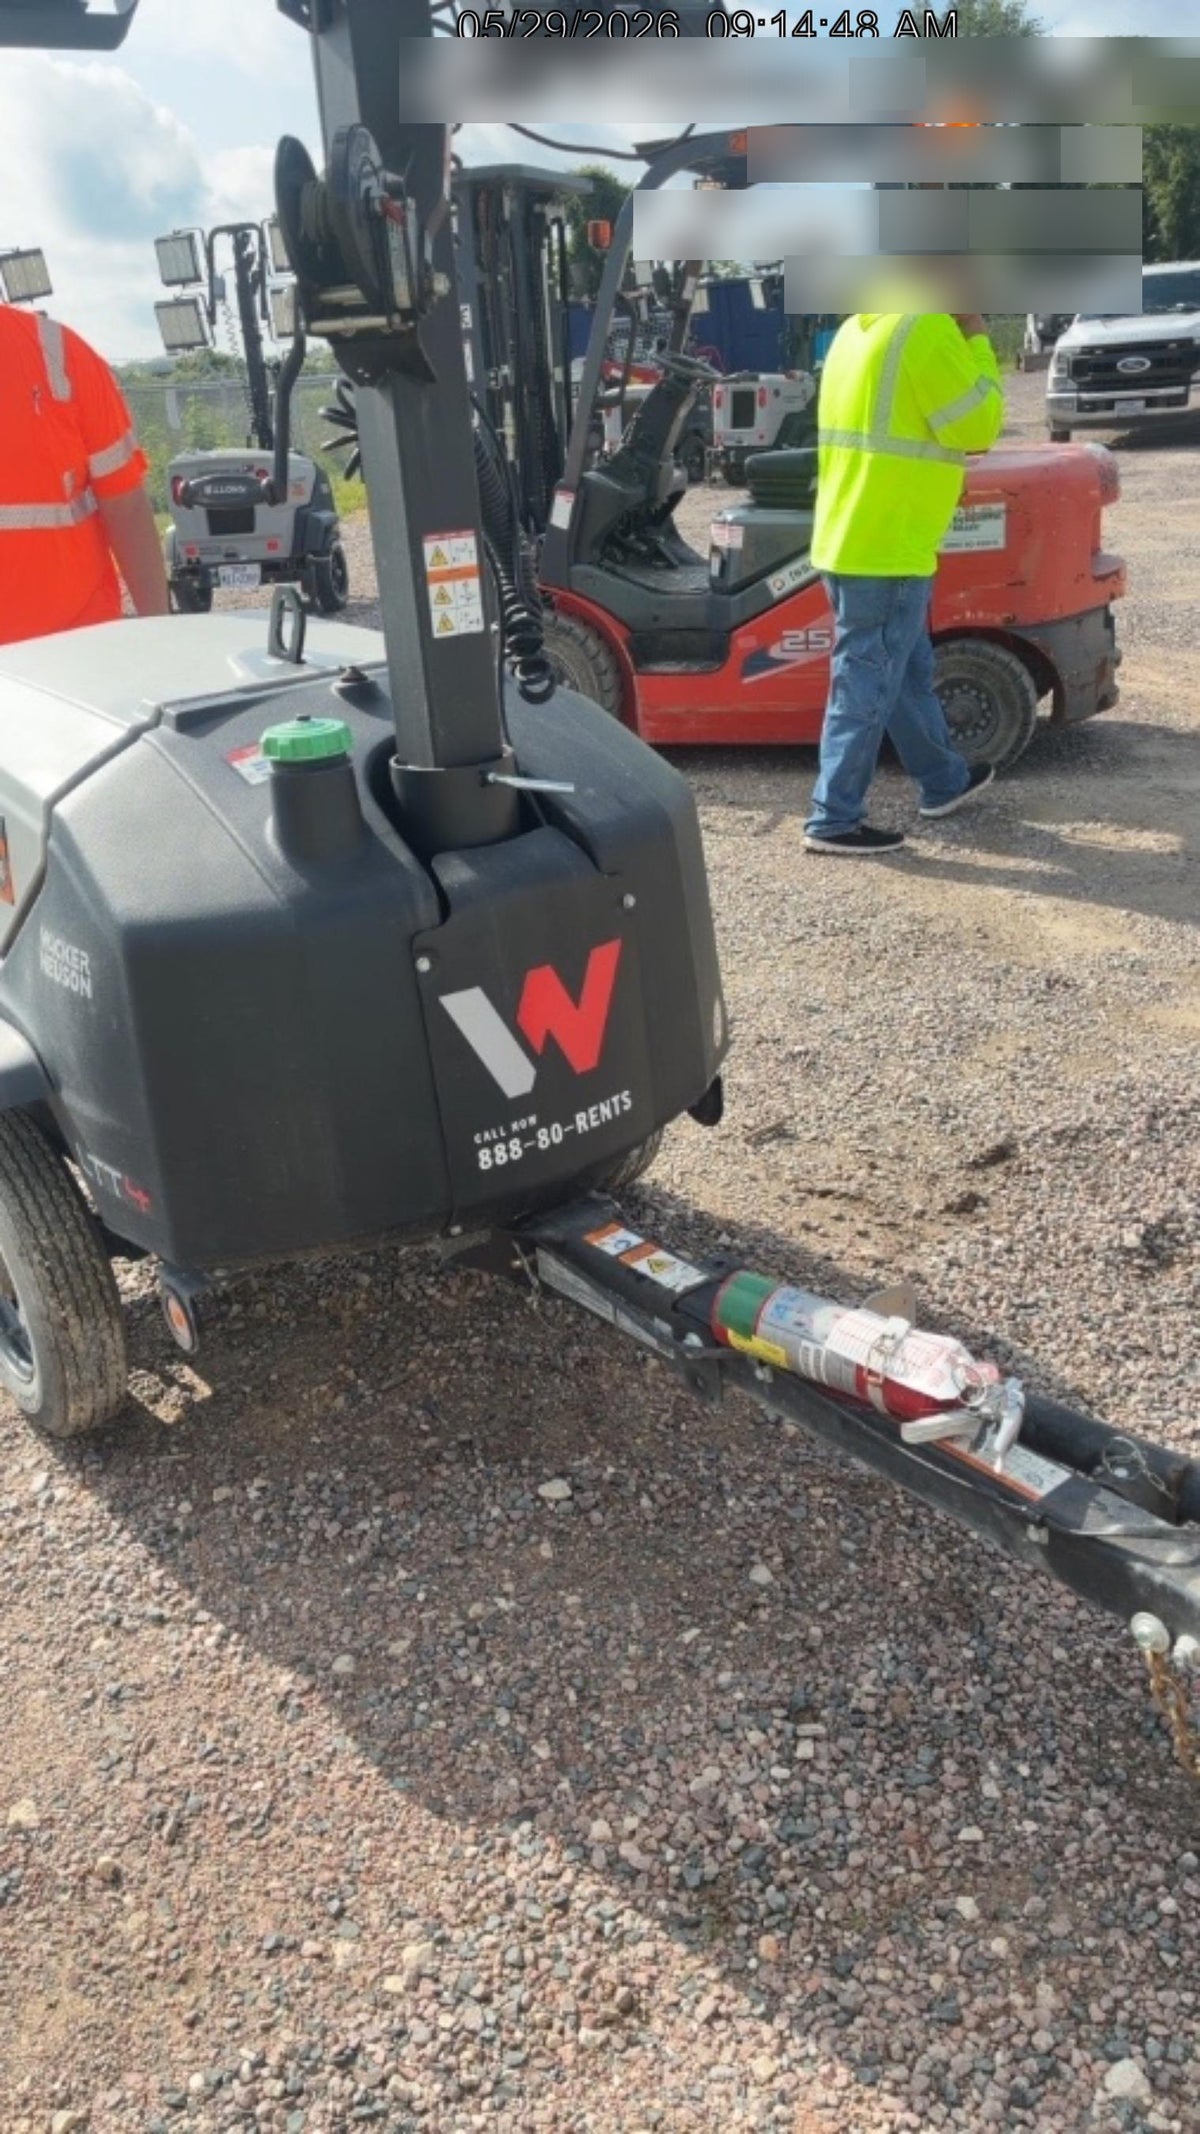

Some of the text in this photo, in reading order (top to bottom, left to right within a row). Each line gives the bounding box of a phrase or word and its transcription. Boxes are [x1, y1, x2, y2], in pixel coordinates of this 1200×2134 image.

[780, 628, 833, 652] 25
[473, 1114, 537, 1145] CALL NOW
[478, 1089, 632, 1170] 888-80-RENTS
